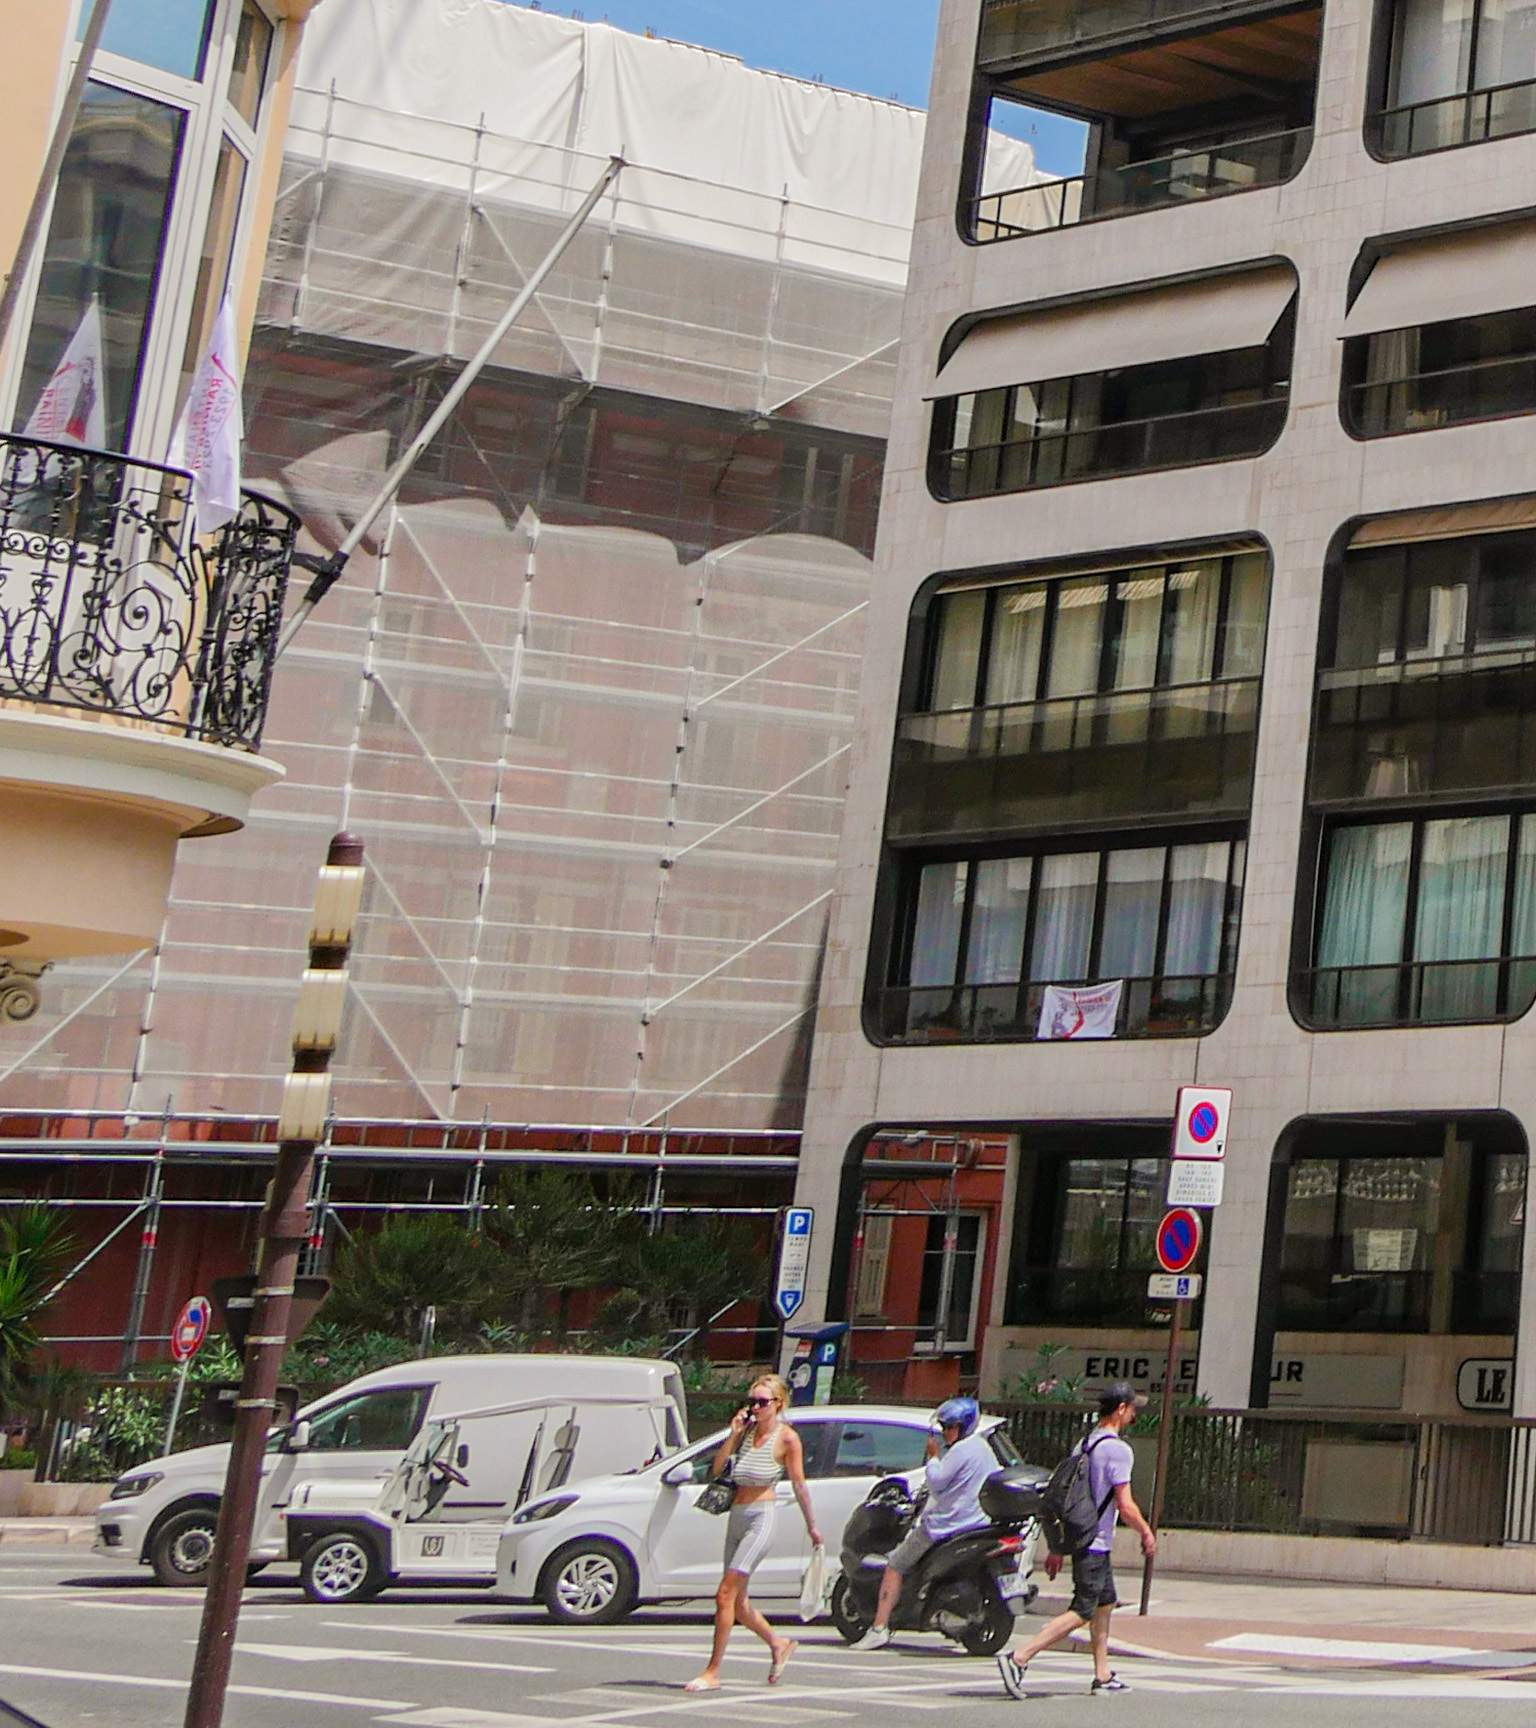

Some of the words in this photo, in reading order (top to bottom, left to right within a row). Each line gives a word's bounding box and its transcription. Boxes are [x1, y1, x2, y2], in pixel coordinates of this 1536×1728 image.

[794, 1215, 806, 1232] P
[823, 1343, 836, 1362] P
[1085, 1357, 1149, 1379] ERIC
[1475, 1368, 1506, 1403] LE
